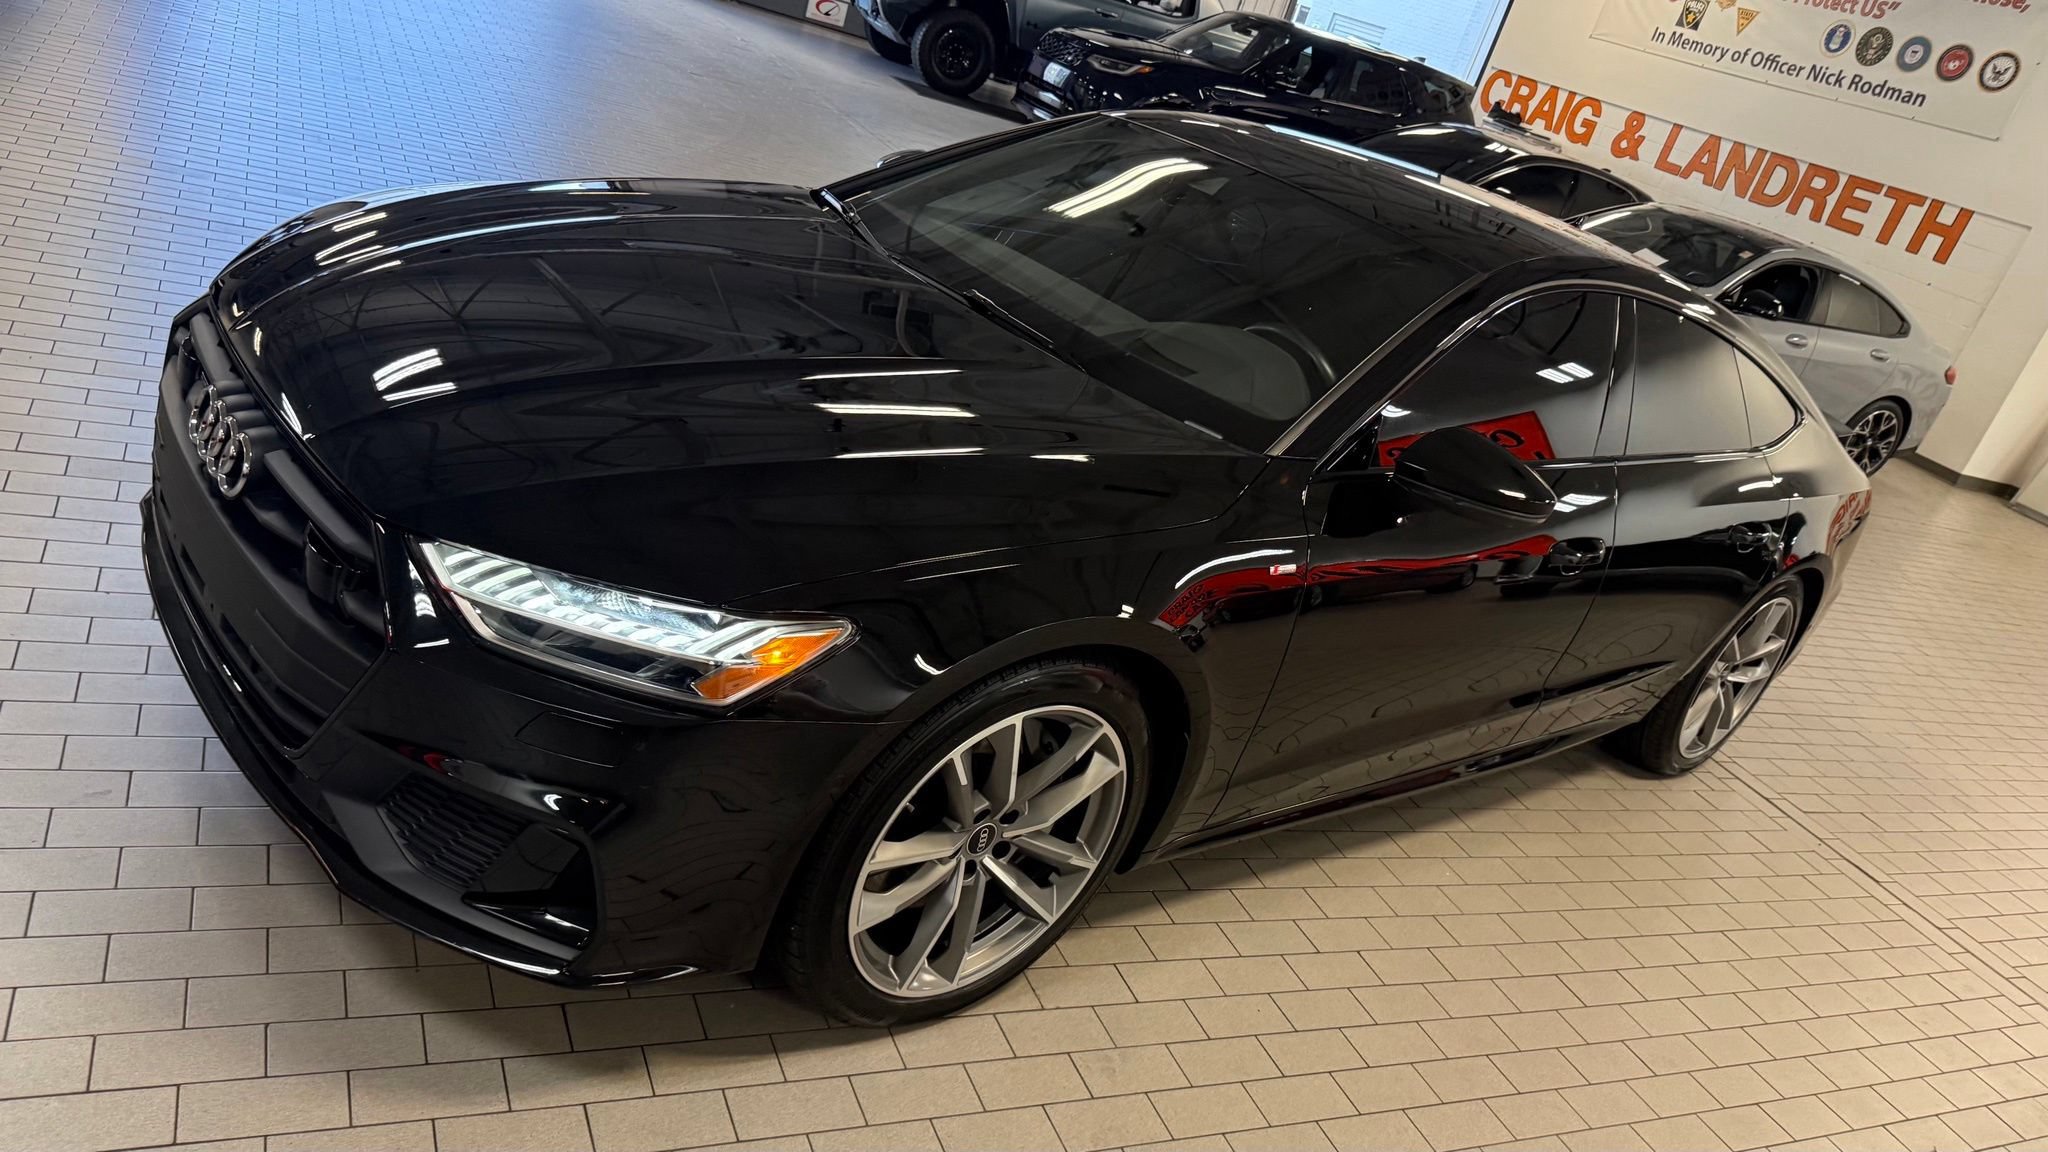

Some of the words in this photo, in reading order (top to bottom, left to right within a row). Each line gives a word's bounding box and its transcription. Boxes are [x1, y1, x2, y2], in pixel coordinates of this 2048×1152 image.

[1651, 27, 1666, 43] In
[1667, 31, 1730, 62] Memory
[1731, 48, 1750, 65] of
[1750, 51, 1805, 78] Officer
[1806, 64, 1847, 89] Nick
[1848, 77, 1927, 107] Rodman
[1480, 69, 1602, 147] CRAIG
[1610, 111, 1646, 161] &
[1653, 123, 1975, 265] LANDRETH
